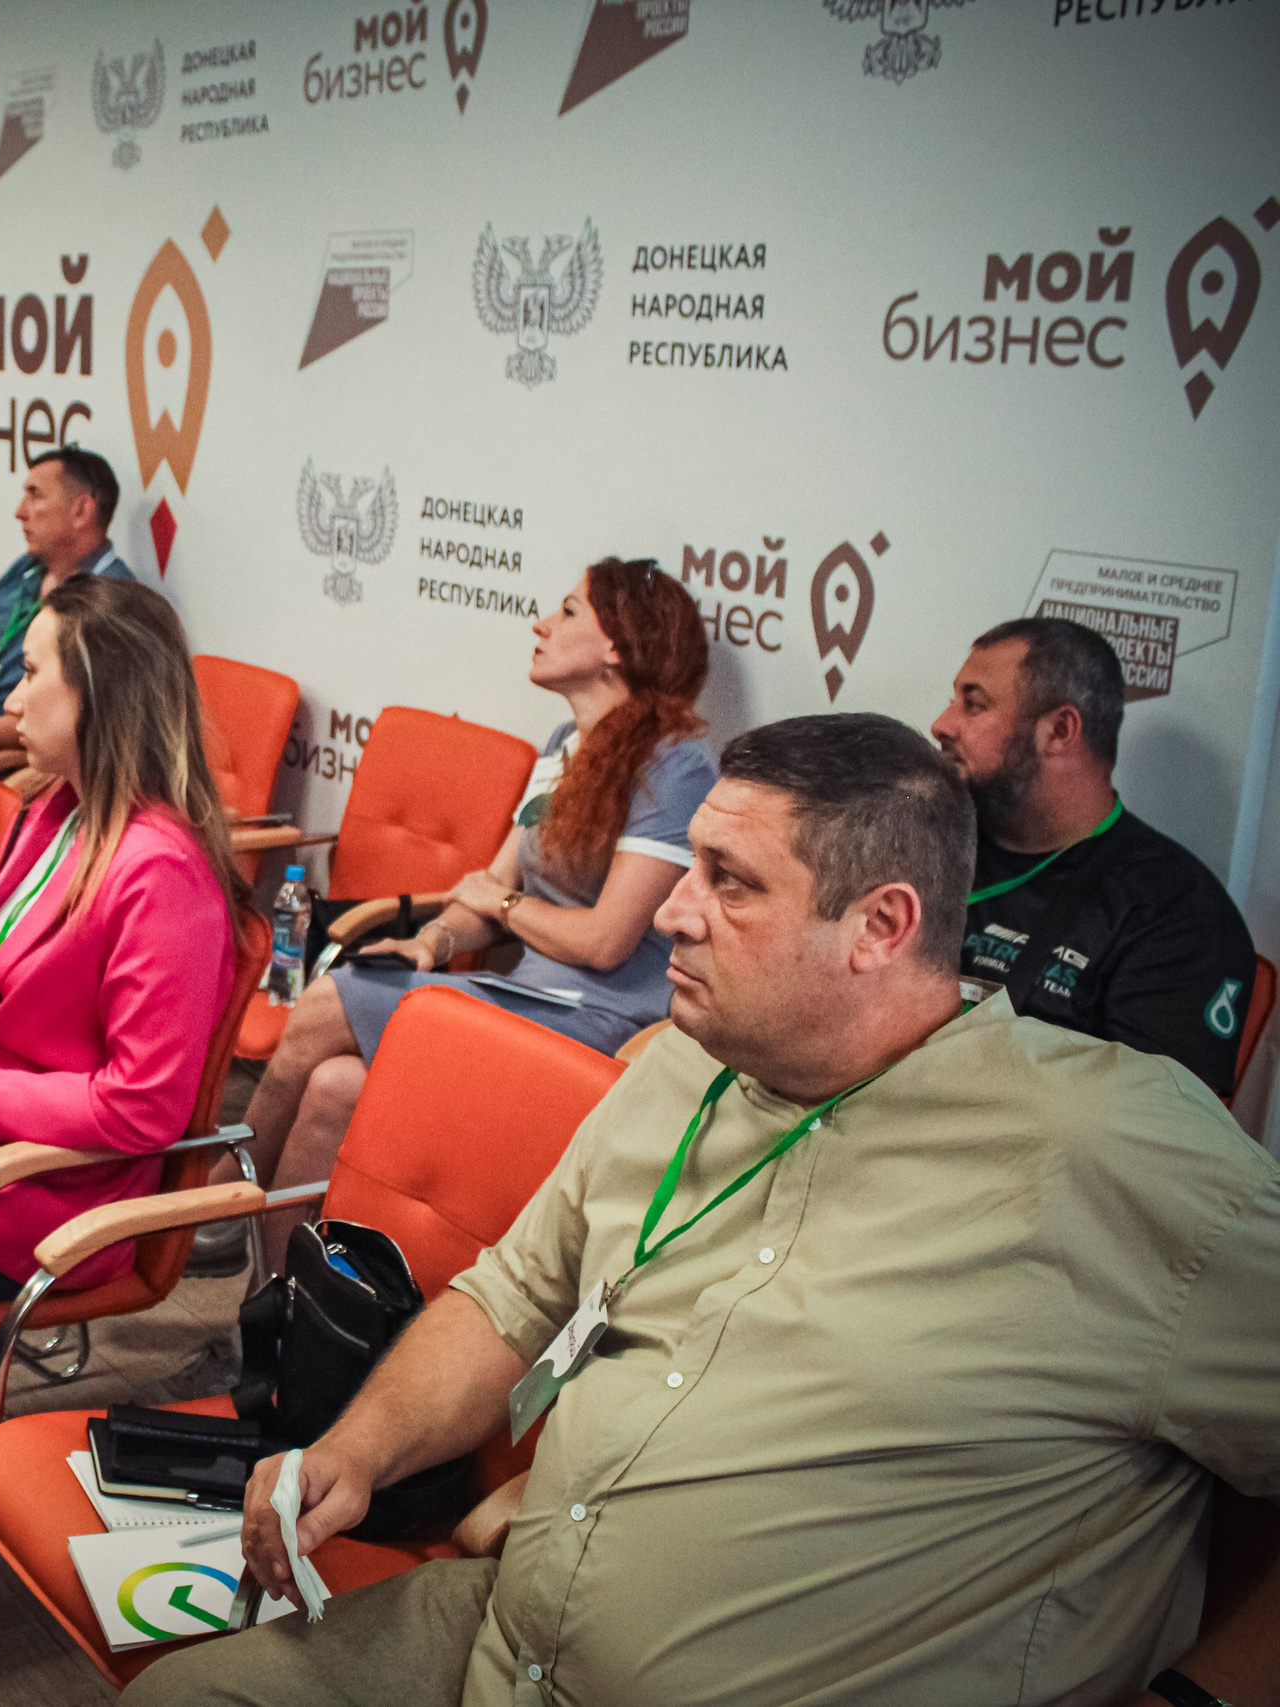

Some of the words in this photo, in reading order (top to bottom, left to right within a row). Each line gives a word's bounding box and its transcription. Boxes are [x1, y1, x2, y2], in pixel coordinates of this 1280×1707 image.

[304, 50, 426, 104] бизнес
[632, 242, 767, 274] ДОНЕЦКАЯ
[983, 226, 1135, 304] мой
[631, 292, 765, 323] НАРОДНАЯ
[883, 290, 1128, 369] бизнес
[629, 340, 788, 371] РЕСПУБЛИКА
[421, 495, 524, 531] ДОНЕЦКАЯ
[420, 536, 522, 573] НАРОДНАЯ
[682, 535, 788, 599] мой
[418, 576, 540, 619] РЕСПУБЛИКА
[1050, 577, 1222, 614] ПРЕДПРИНИМАТЕЛЬСТВО
[1098, 566, 1144, 585] МАЛОЕ
[1147, 572, 1158, 586] И
[1160, 573, 1224, 596] СРЕДНЕЕ
[330, 708, 372, 748] мо
[283, 722, 357, 784] бизн
